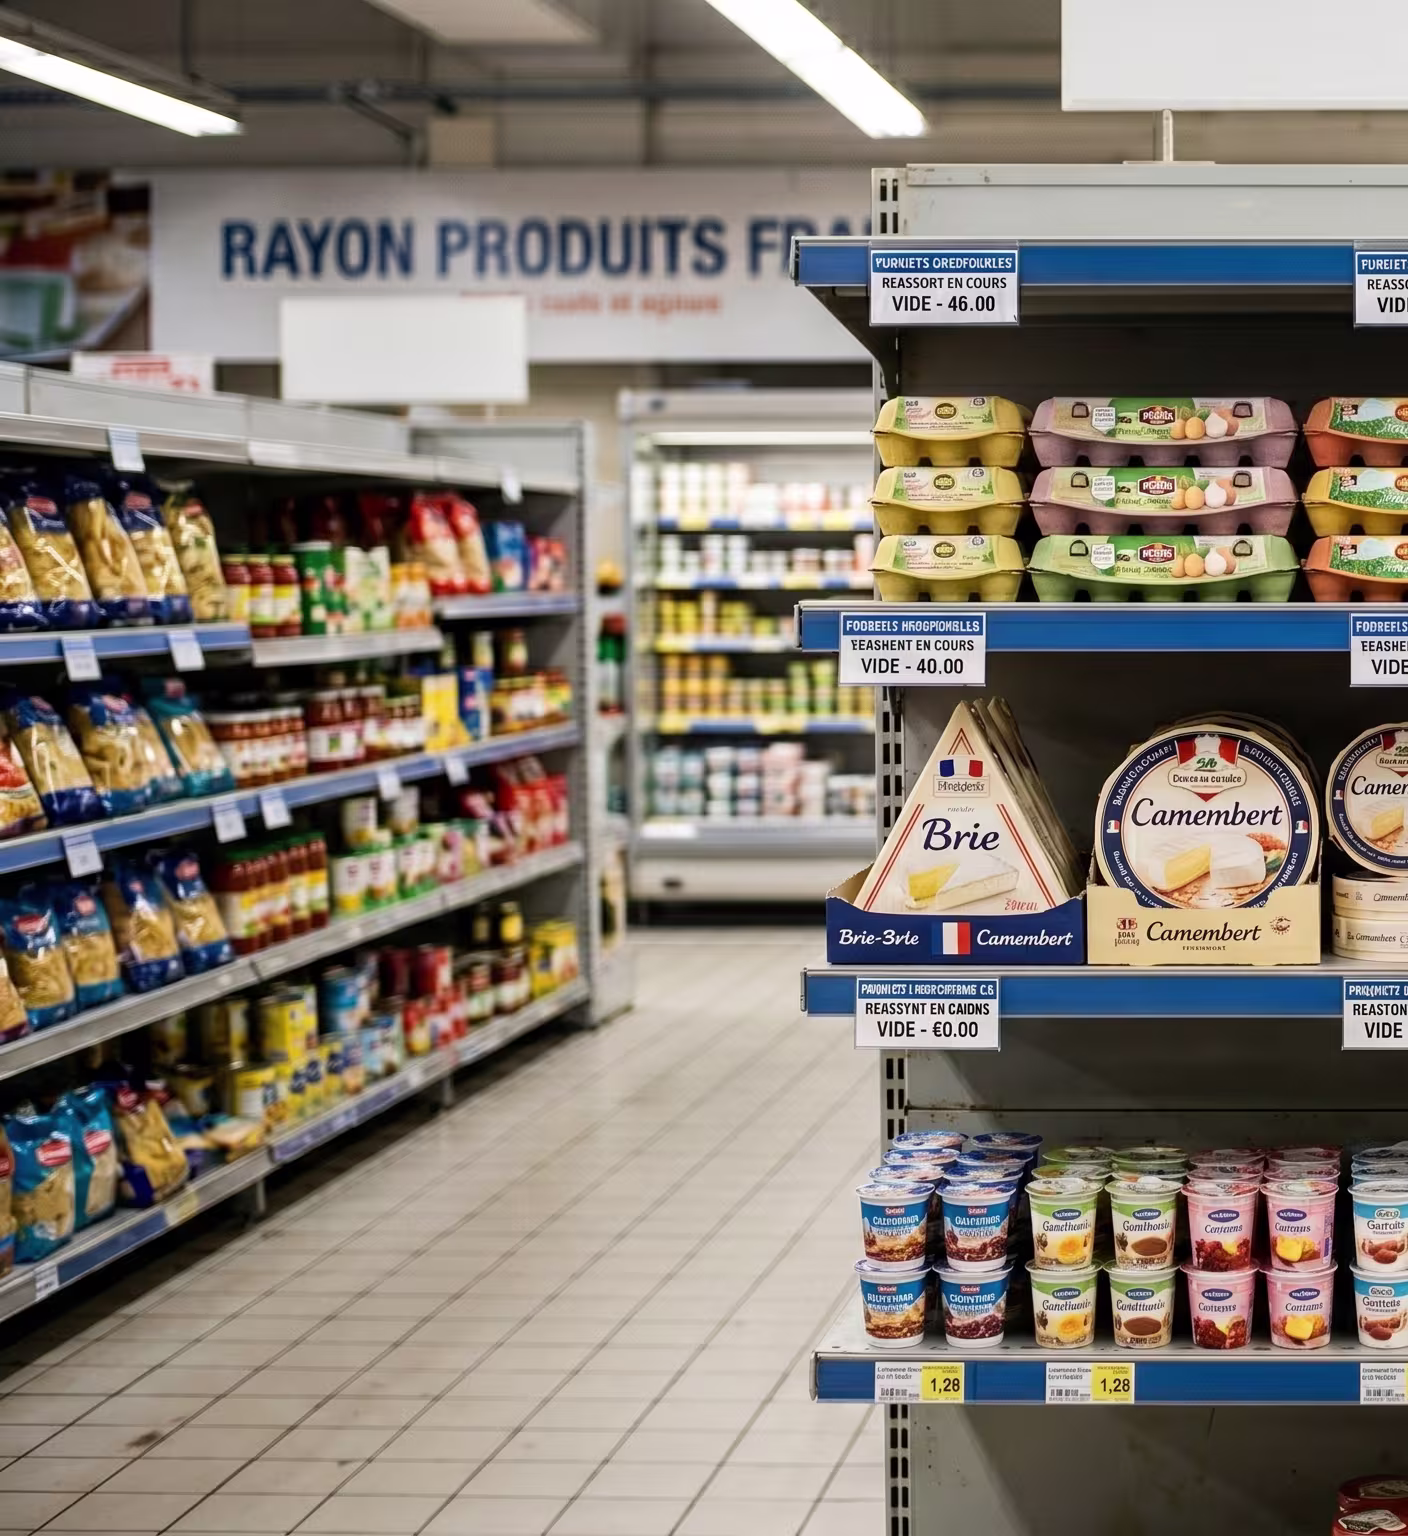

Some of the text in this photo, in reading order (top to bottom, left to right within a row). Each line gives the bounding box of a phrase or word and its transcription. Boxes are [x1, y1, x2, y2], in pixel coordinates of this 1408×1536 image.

[220, 219, 412, 280] RAYON
[435, 217, 727, 279] PRODUITS
[882, 277, 1007, 289] REASSORT EN COURS
[892, 295, 932, 312] VIDE
[947, 295, 996, 312] 46.00
[916, 639, 931, 651] EN
[934, 639, 975, 651] COURS
[861, 658, 900, 674] VIDE
[1131, 797, 1283, 827] Camembert
[922, 817, 1000, 851] Brie
[976, 929, 1074, 946] Camembert
[1146, 921, 1262, 942] Camembert
[865, 1002, 927, 1015] REASSYNT
[930, 1002, 945, 1015] EN
[877, 1021, 915, 1037] VIDE
[932, 1021, 978, 1038] €0.00
[1364, 1022, 1403, 1038] VIDE
[930, 1377, 960, 1395] 1,28
[1099, 1377, 1130, 1395] 1,28
